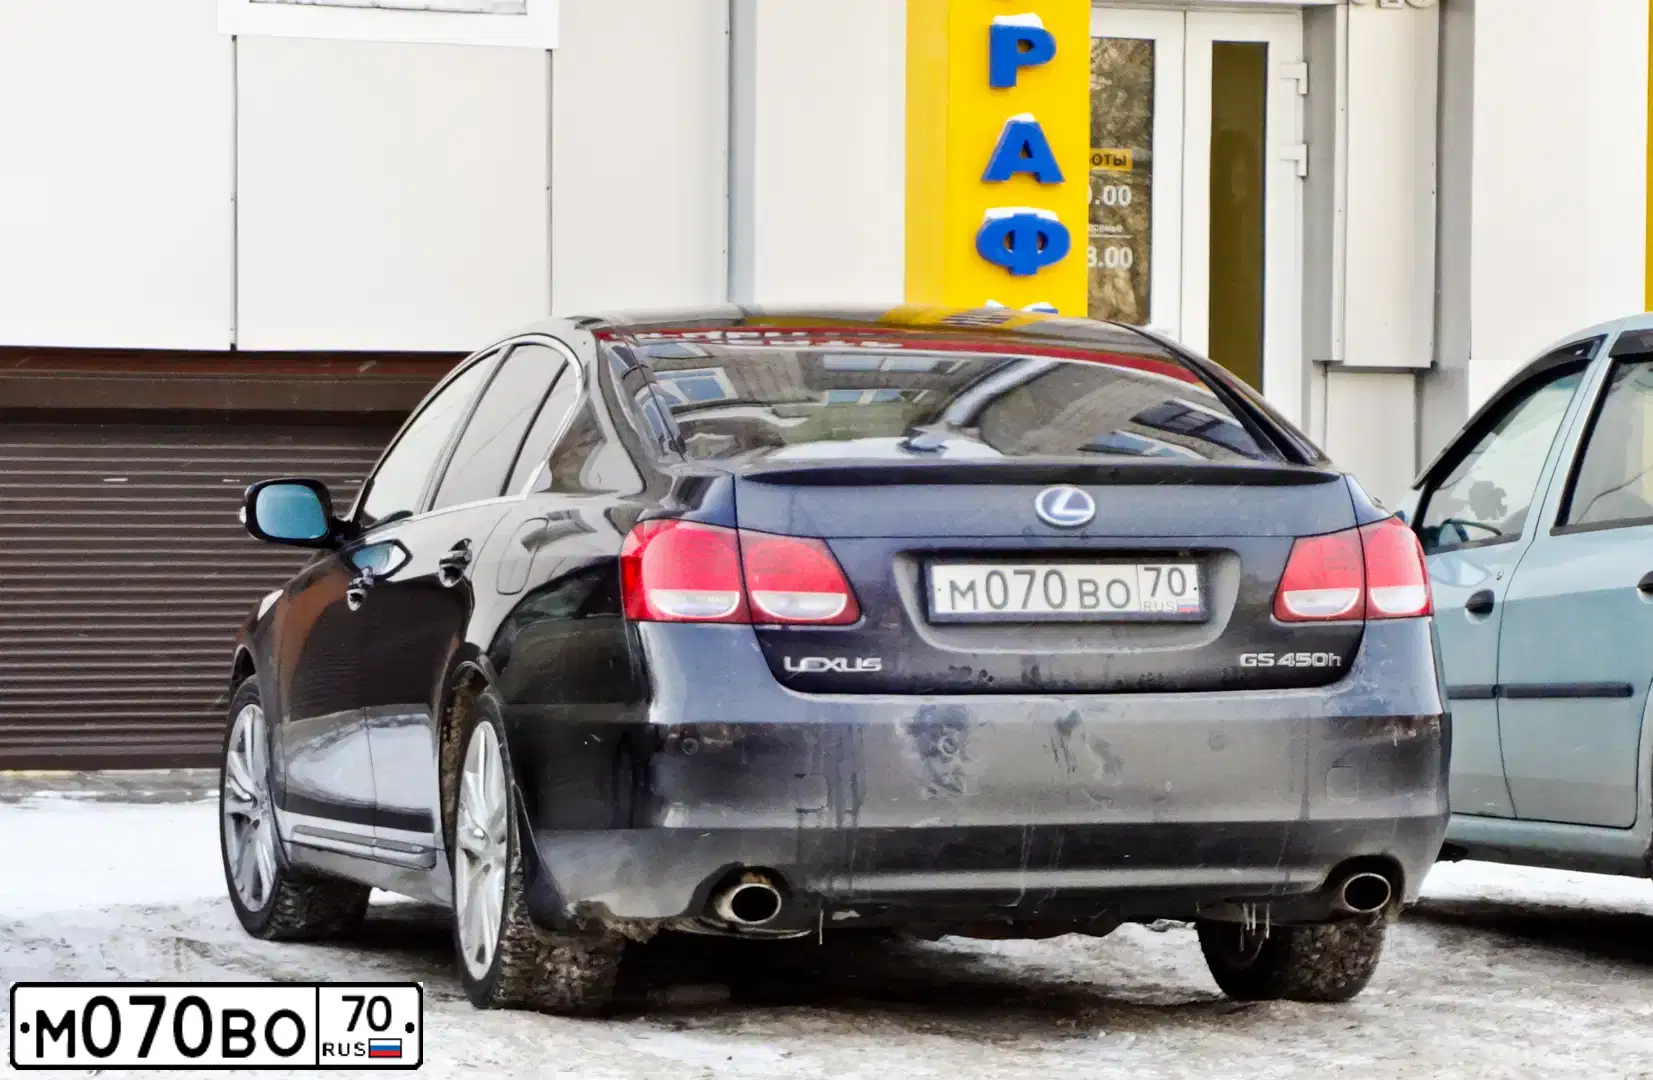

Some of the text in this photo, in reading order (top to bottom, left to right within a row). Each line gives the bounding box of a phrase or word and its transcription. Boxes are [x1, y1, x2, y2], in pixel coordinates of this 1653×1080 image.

[975, 22, 1071, 314] РАФ
[1143, 566, 1187, 597] 70
[1143, 601, 1176, 613] RUS
[783, 656, 882, 672] LEXUS
[1240, 652, 1341, 667] GS 450h
